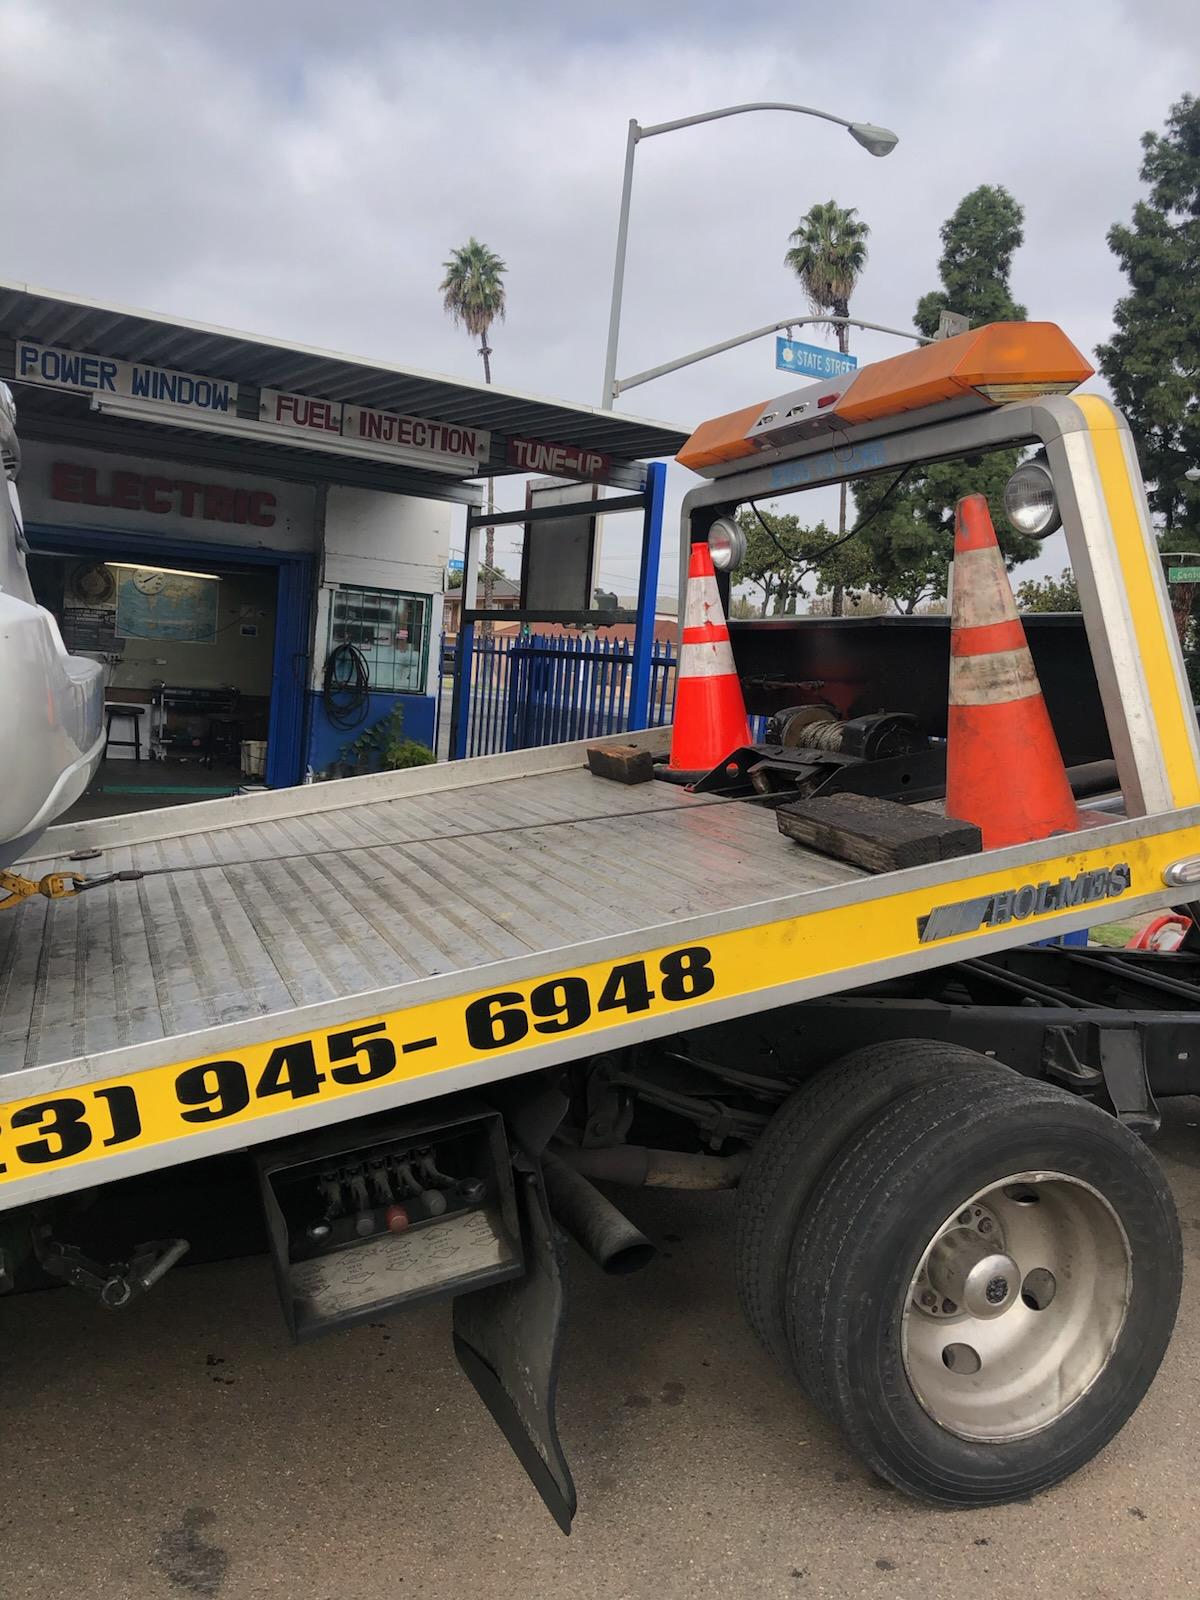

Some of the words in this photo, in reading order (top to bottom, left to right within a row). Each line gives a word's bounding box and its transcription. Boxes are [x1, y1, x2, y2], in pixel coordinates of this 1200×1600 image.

[20, 346, 118, 392] POWER
[132, 367, 229, 412] WINDOW
[797, 350, 822, 370] STATE
[276, 394, 339, 432] FUEL
[359, 411, 476, 457] INJECTION
[513, 440, 603, 479] TUNE-UP
[52, 462, 277, 527] ELECTRIC
[986, 863, 1131, 927] HOLMES
[465, 946, 715, 1050] 6948
